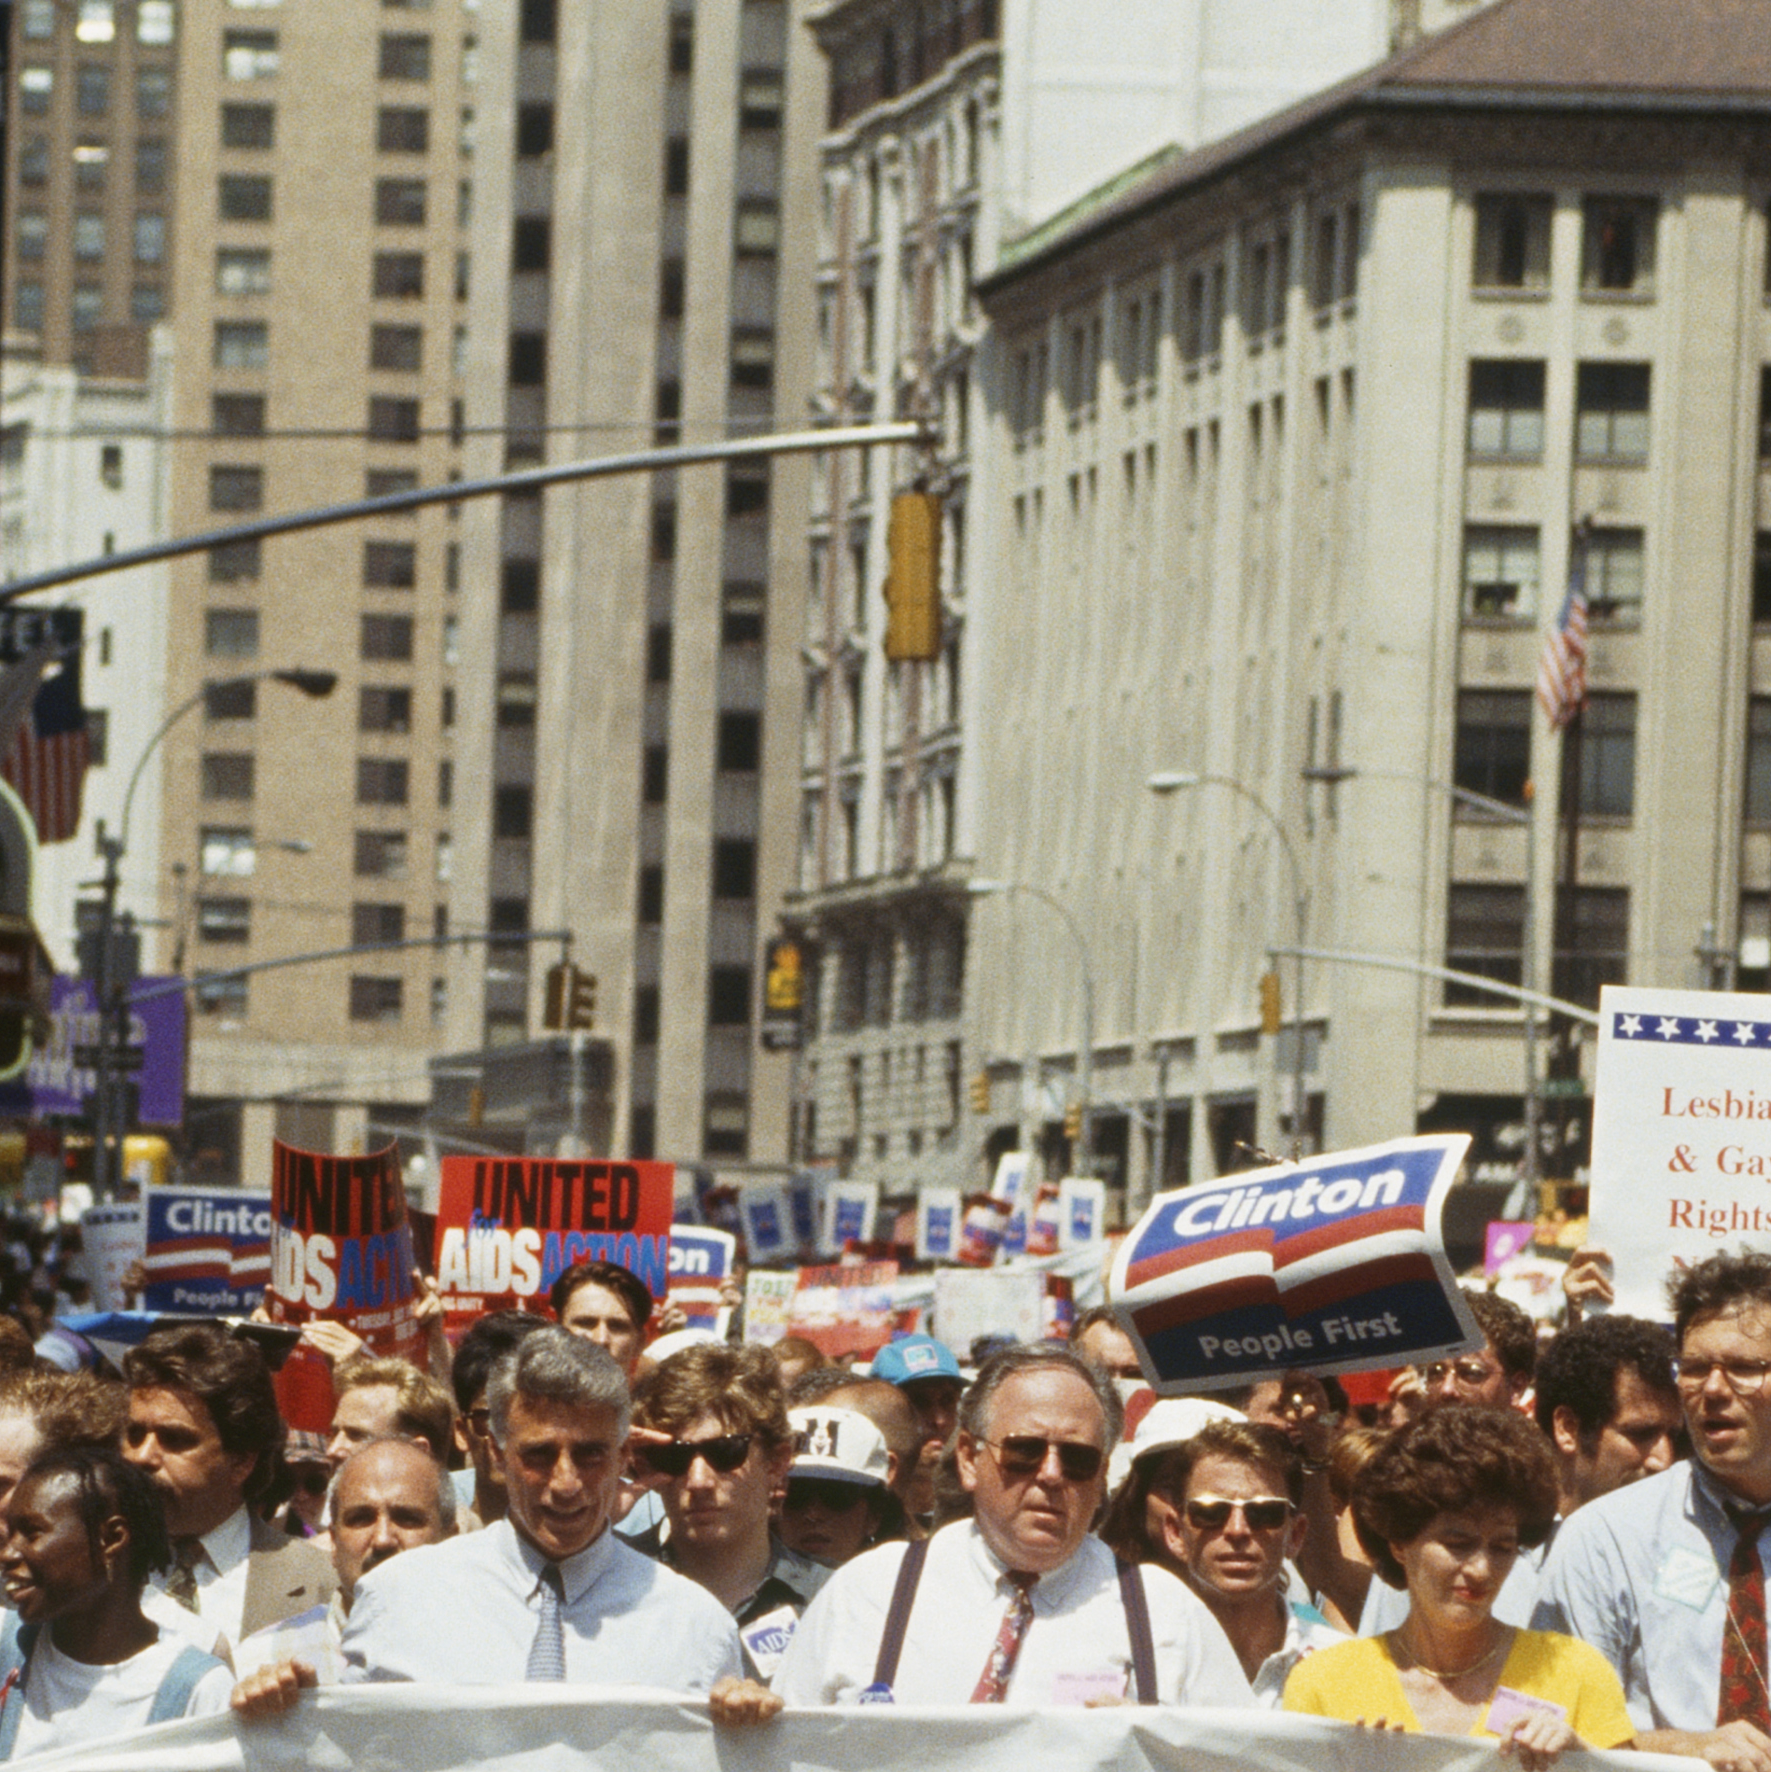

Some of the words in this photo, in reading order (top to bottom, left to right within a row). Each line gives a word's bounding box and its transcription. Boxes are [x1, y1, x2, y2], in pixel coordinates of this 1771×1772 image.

[1668, 1143, 1698, 1173] &
[472, 1161, 641, 1231] UNITED
[1173, 1168, 1406, 1237] Clinton
[438, 1227, 542, 1296] AIDS
[173, 1288, 238, 1310] People
[1197, 1323, 1314, 1361] People
[1321, 1310, 1403, 1345] First
